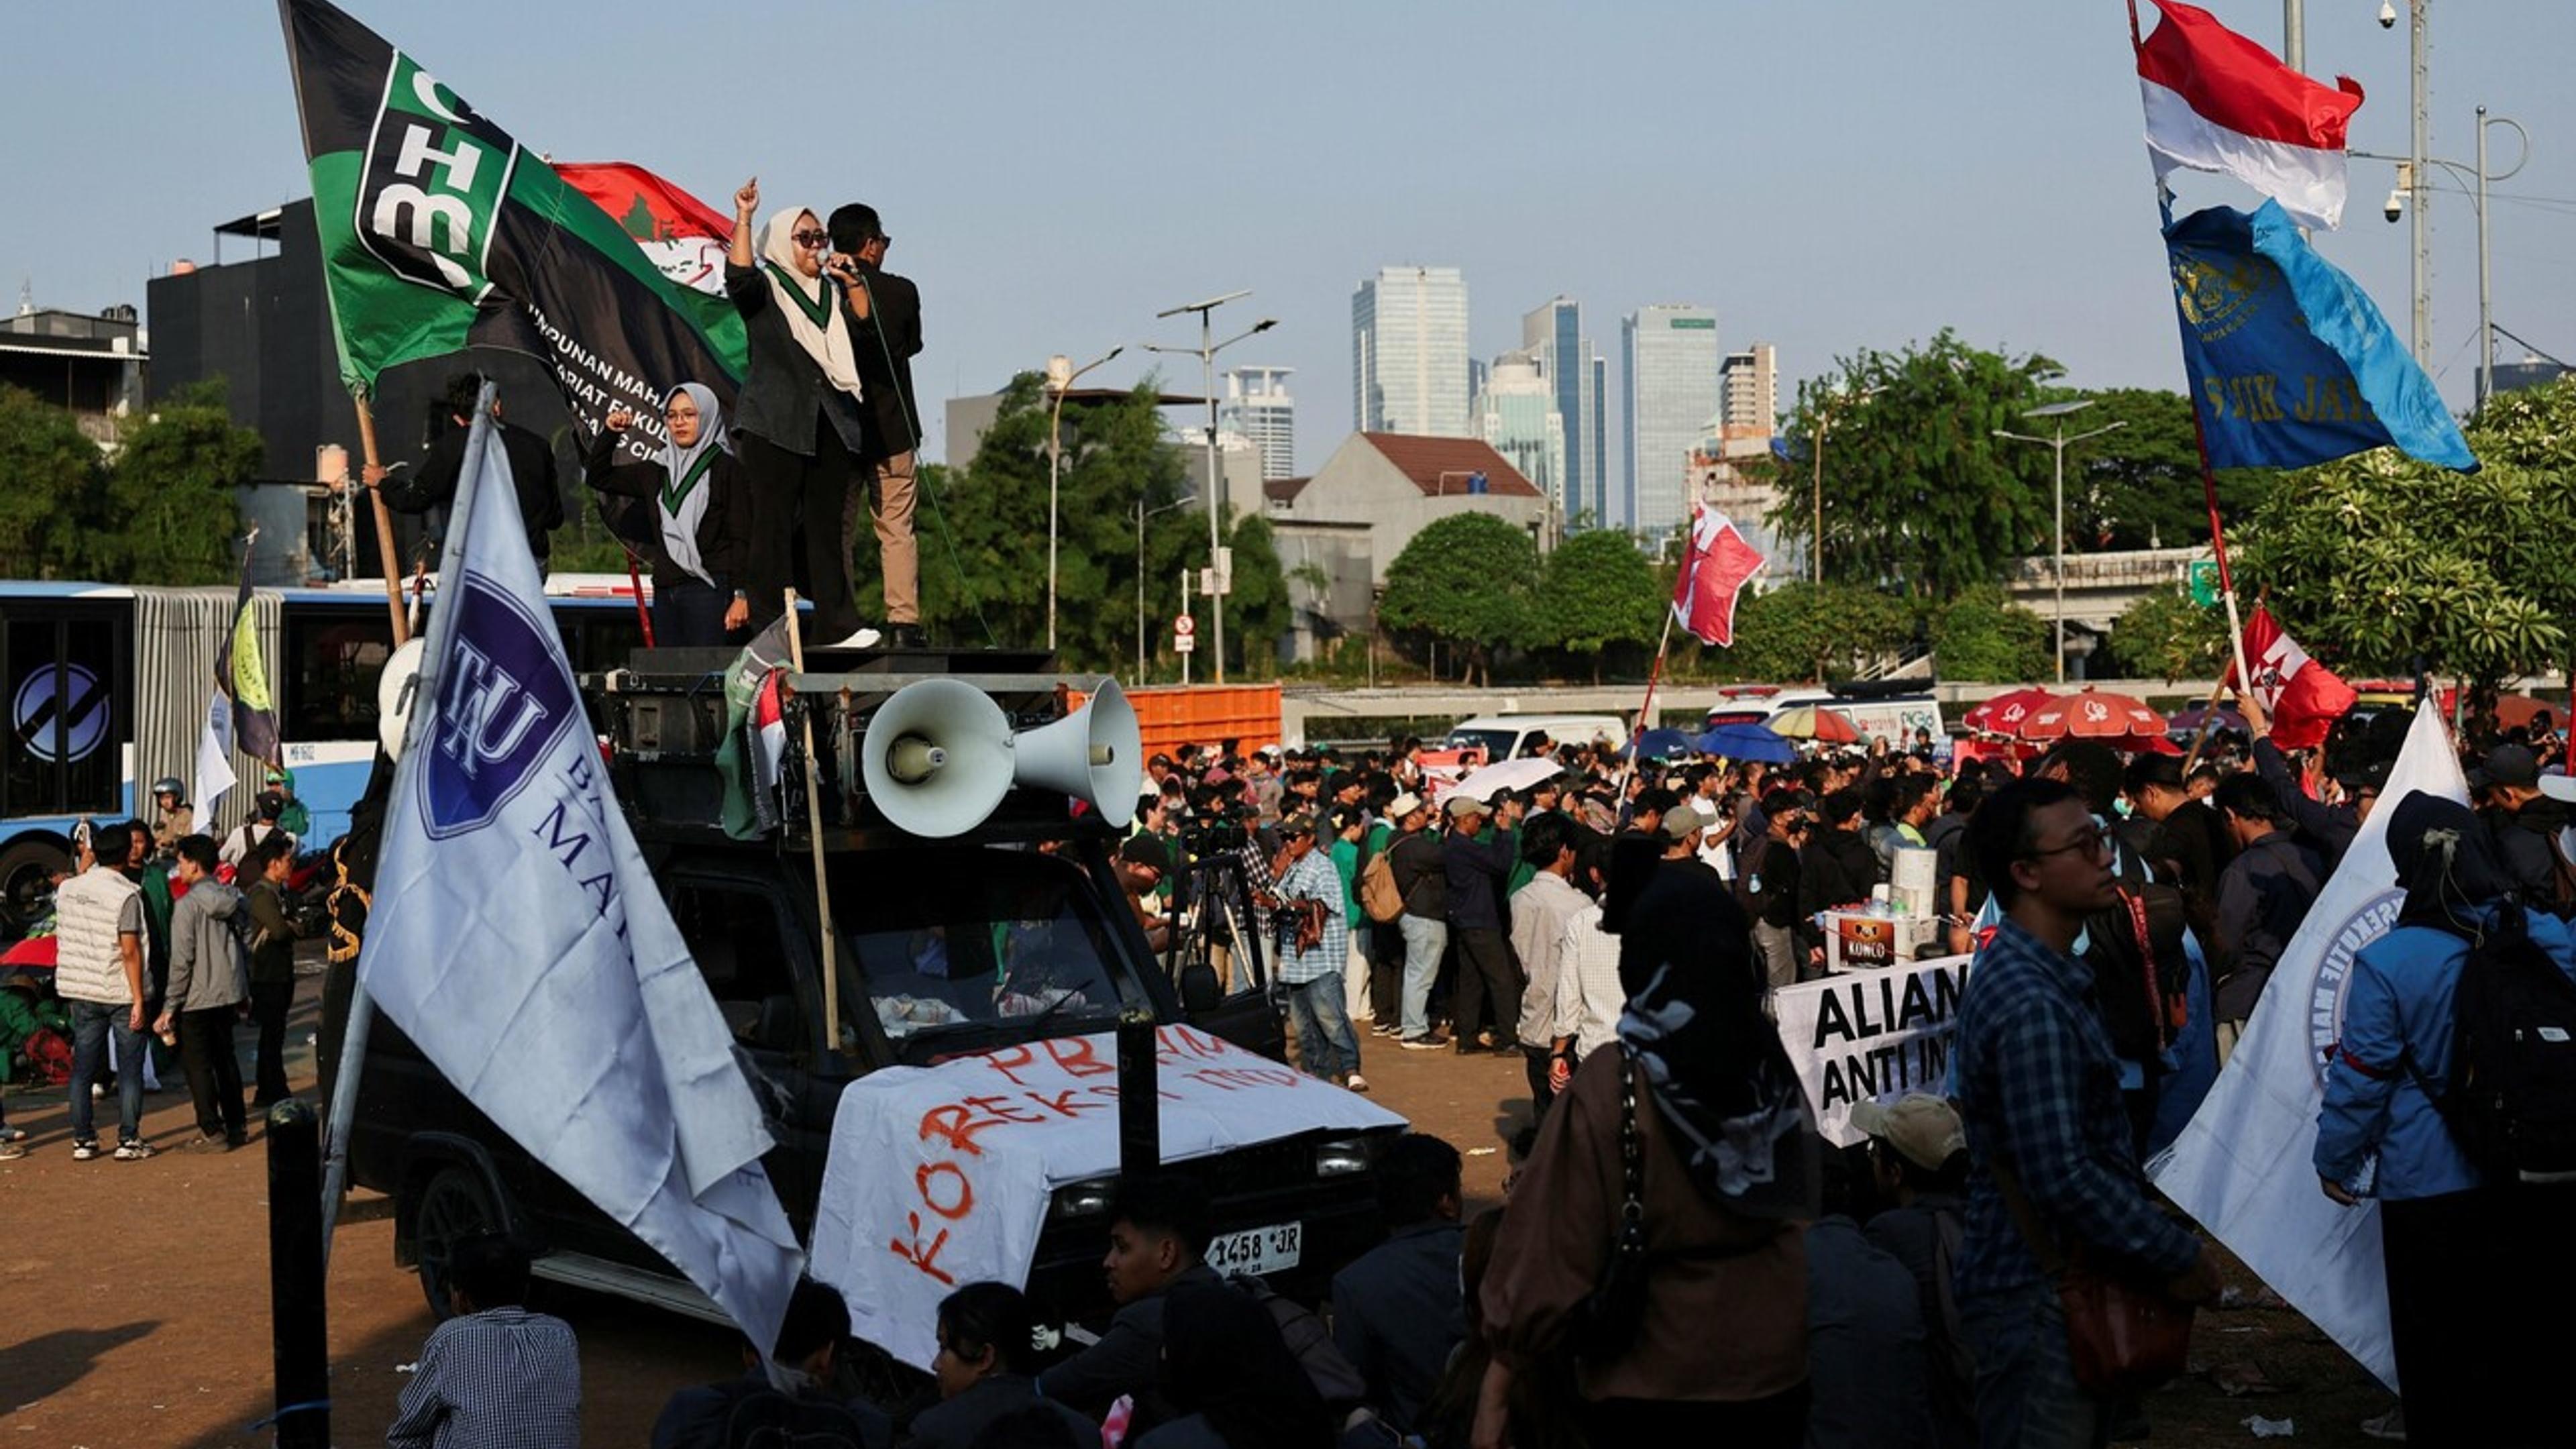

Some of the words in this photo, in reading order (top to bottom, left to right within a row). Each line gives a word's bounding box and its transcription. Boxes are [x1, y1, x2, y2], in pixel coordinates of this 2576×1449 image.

[614, 371, 667, 411] MAH
[1814, 963, 1968, 1050] ALIAN
[1823, 1043, 1909, 1111] ANTI
[1919, 1028, 1955, 1085] IN
[1216, 1233, 1261, 1266] 1458
